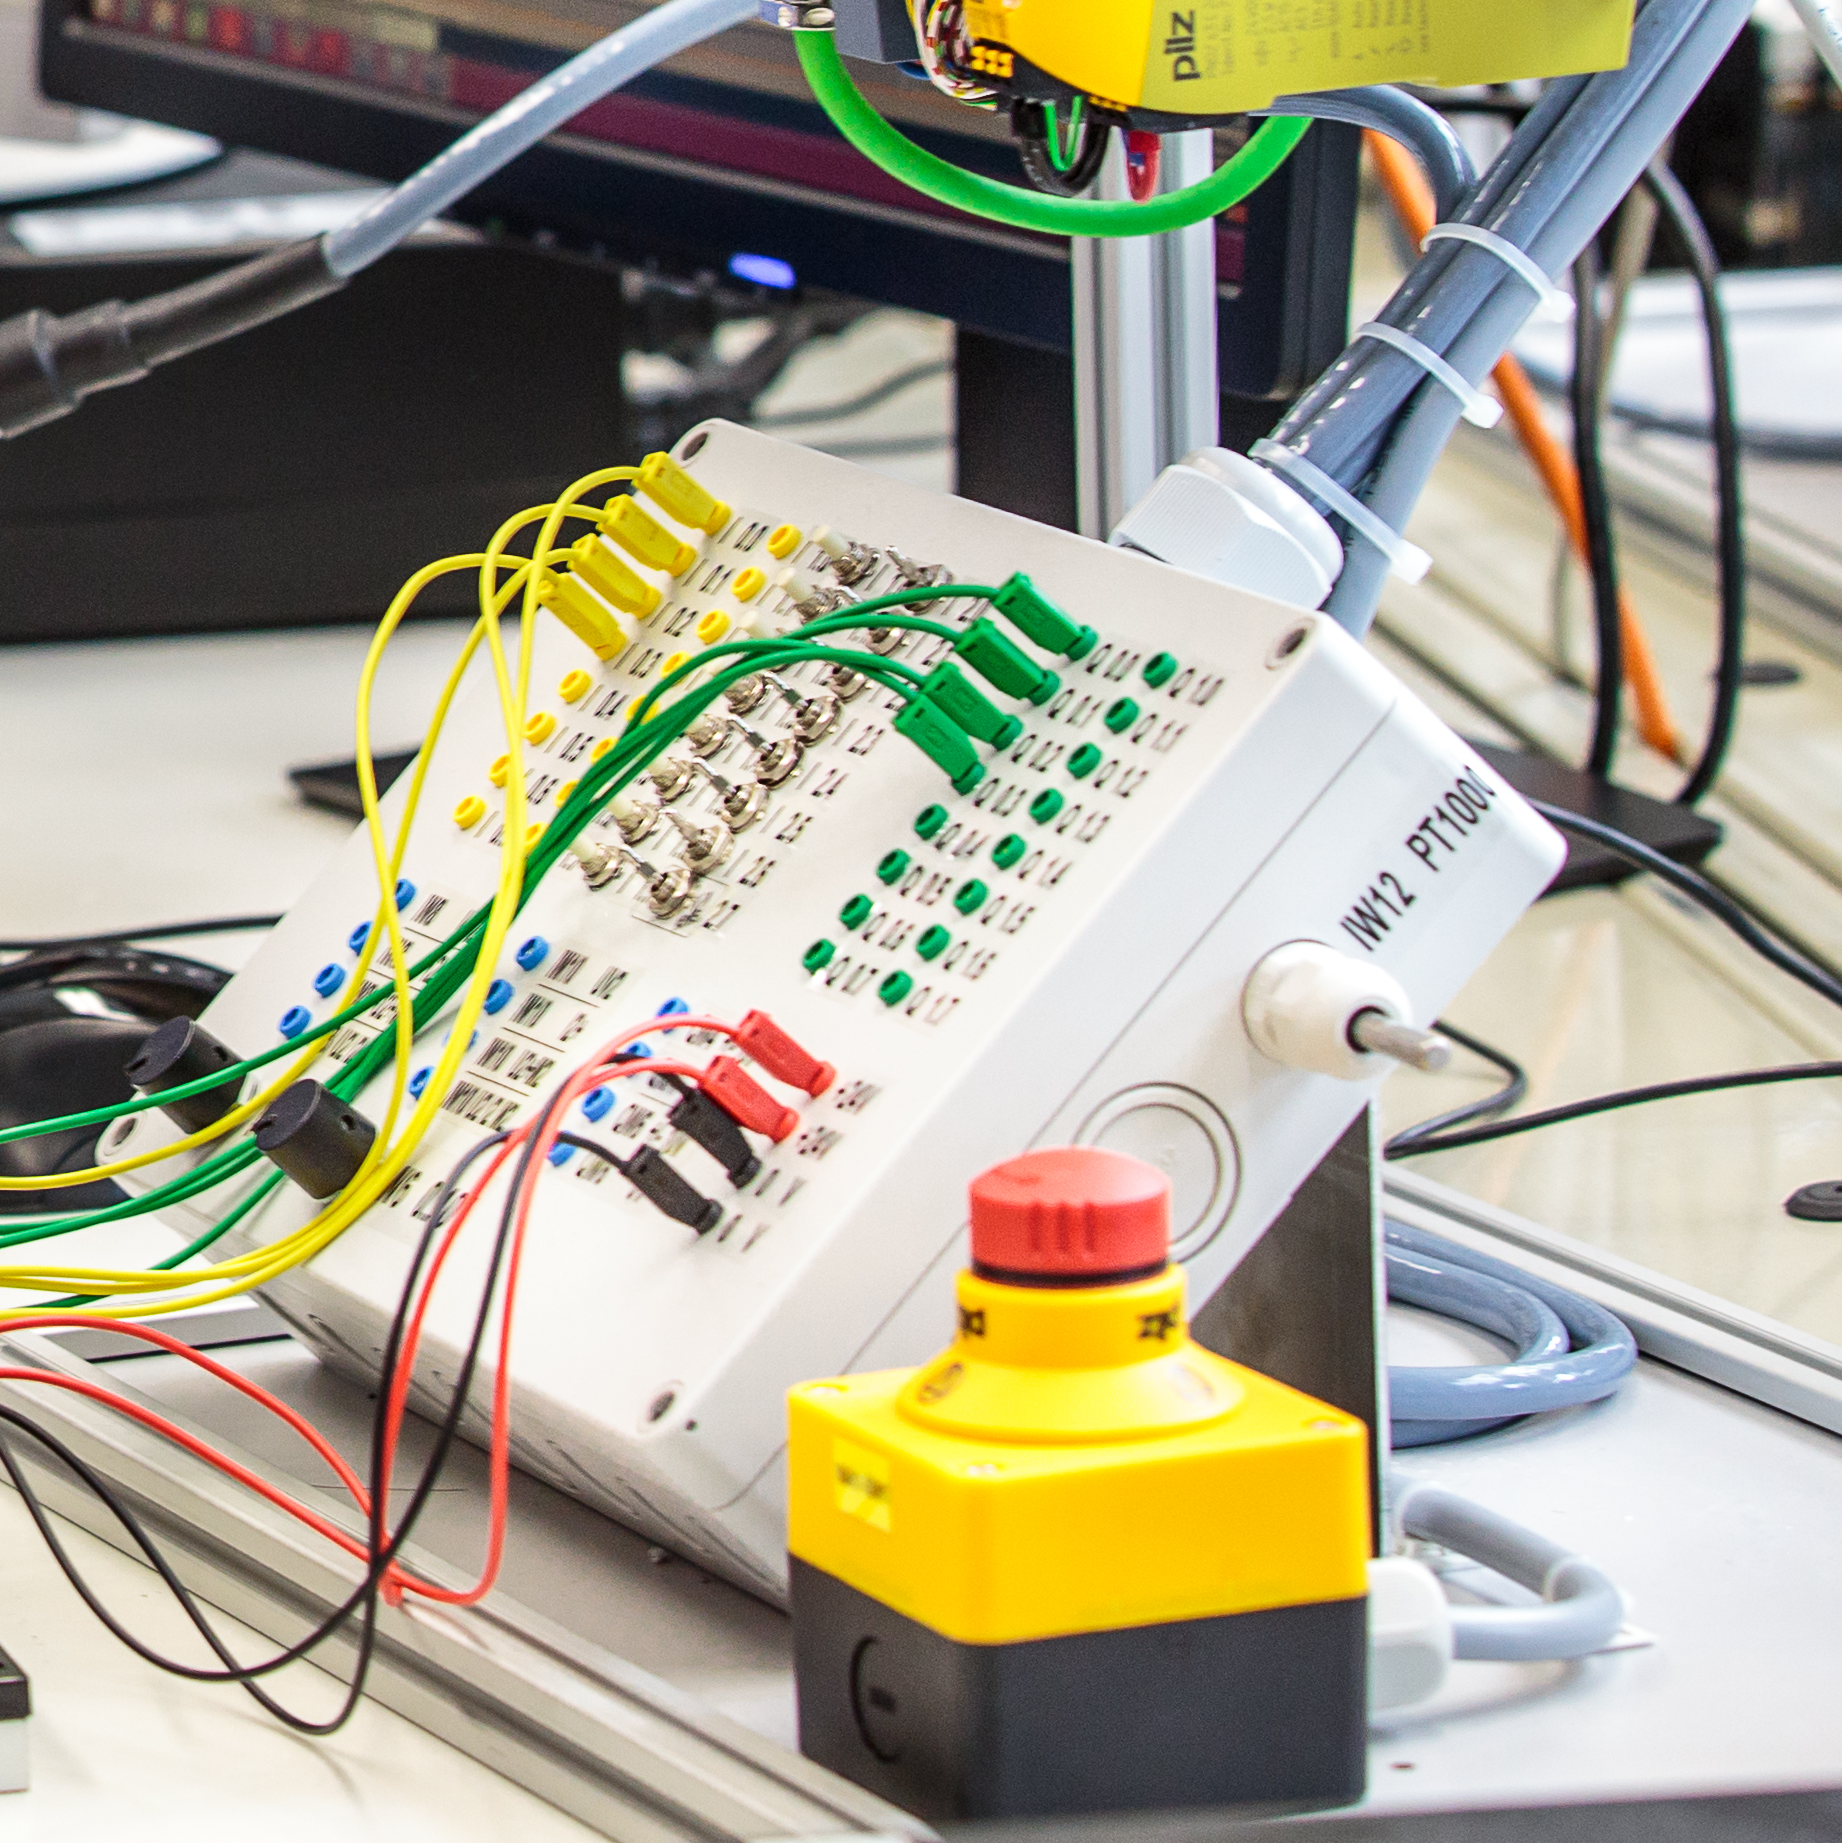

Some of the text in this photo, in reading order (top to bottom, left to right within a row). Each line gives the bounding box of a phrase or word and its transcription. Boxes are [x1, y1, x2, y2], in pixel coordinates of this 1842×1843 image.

[1162, 9, 1202, 82] pilz
[733, 522, 769, 552] 0.0
[699, 564, 733, 592] 0.1
[663, 607, 698, 637] 0.2
[628, 648, 663, 678] 0.3
[1085, 644, 1140, 682] Q 0.0
[594, 690, 627, 717] 0.4
[1169, 668, 1224, 707] Q 1.0
[1047, 689, 1103, 726] Q 0.1
[559, 733, 594, 762] 0.5
[848, 725, 884, 756] 2.3
[1131, 714, 1188, 752] Q 1.1
[1011, 734, 1065, 773] Q 0.2
[526, 775, 558, 805] 0.6
[811, 769, 845, 797] 2.4
[974, 778, 1027, 817] Q 0.3
[1093, 760, 1149, 799] Q 1.2
[775, 813, 812, 843] 2.5
[934, 823, 987, 858] Q 0.4
[1056, 805, 1110, 844] Q 1.3
[900, 865, 952, 906] Q 0.5
[1018, 850, 1071, 887] Q 1.4
[415, 895, 447, 925] IW8
[980, 896, 1035, 935] Q 1.5
[1340, 871, 1417, 952] IW12
[862, 912, 914, 951] Q 0.6
[943, 941, 997, 980] Q 1.6
[841, 964, 879, 996] 0.7
[924, 996, 961, 1026] 1.7
